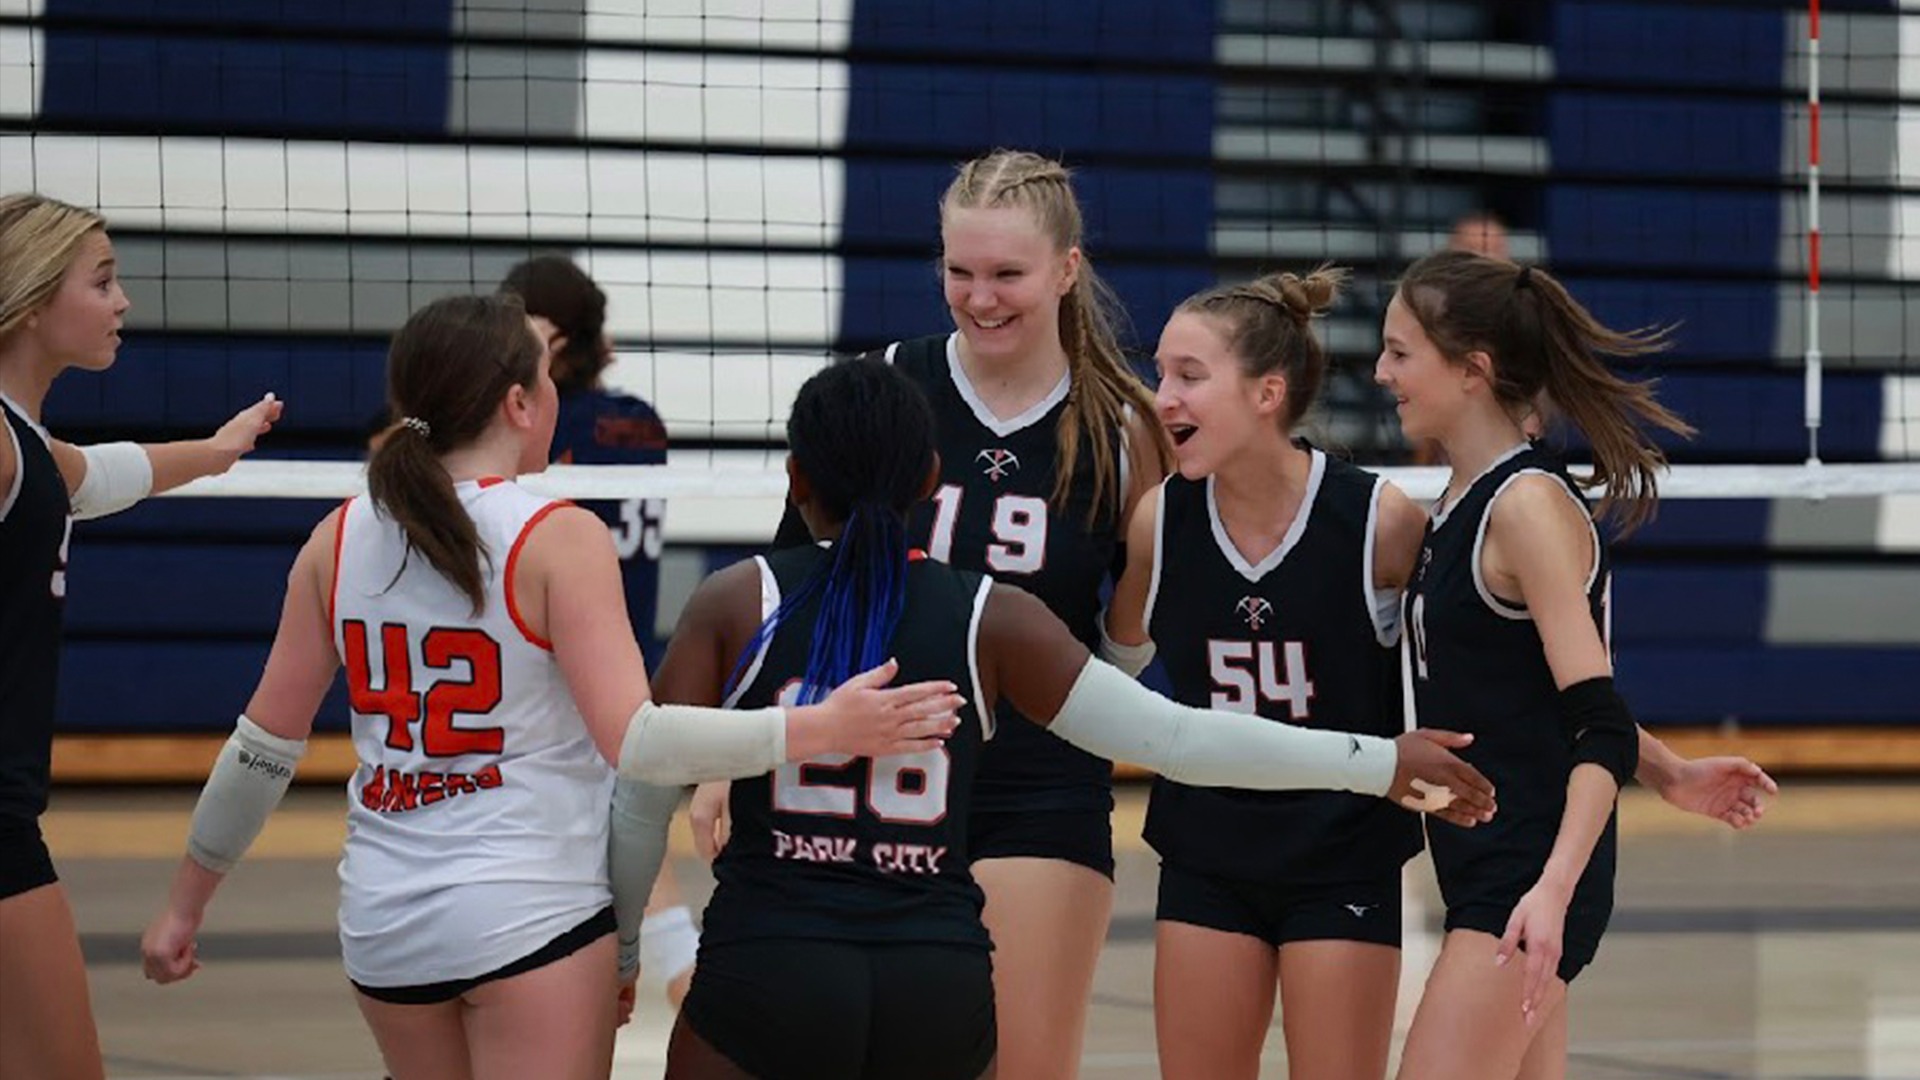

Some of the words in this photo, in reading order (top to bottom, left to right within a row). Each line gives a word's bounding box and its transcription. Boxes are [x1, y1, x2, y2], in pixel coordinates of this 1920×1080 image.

[927, 482, 1049, 574] 19
[342, 619, 504, 757] 42
[1206, 639, 1315, 719] 54
[771, 828, 858, 863] PARK
[870, 842, 948, 874] CITY
